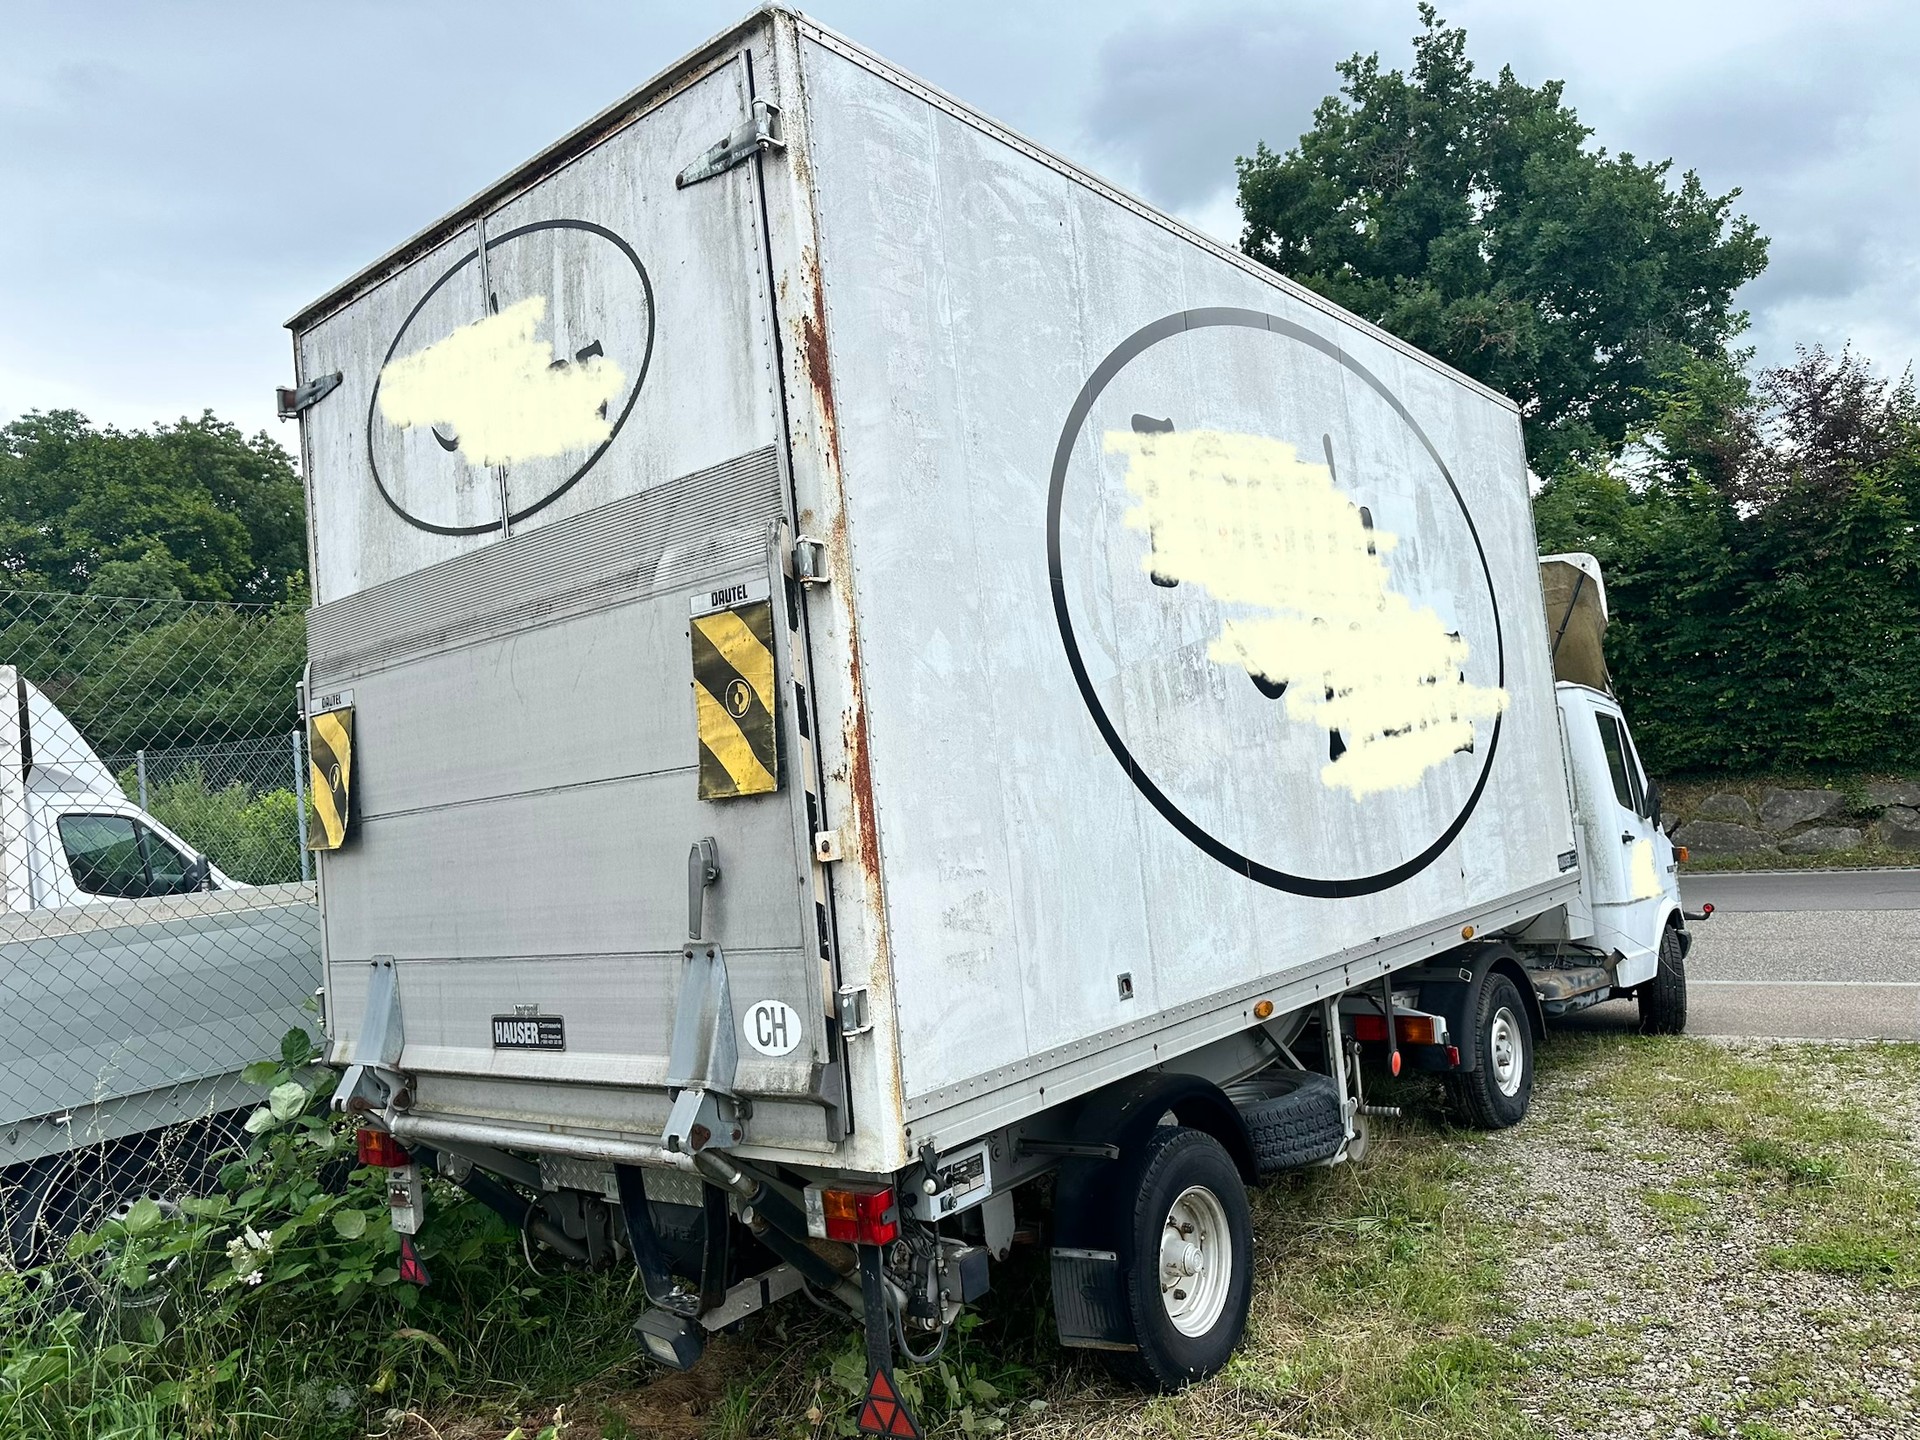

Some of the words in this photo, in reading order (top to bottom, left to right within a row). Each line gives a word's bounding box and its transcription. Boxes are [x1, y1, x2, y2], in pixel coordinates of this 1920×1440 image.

[711, 585, 748, 607] DAUTEL
[495, 1021, 539, 1044] HAUSER
[756, 1006, 788, 1048] CH
